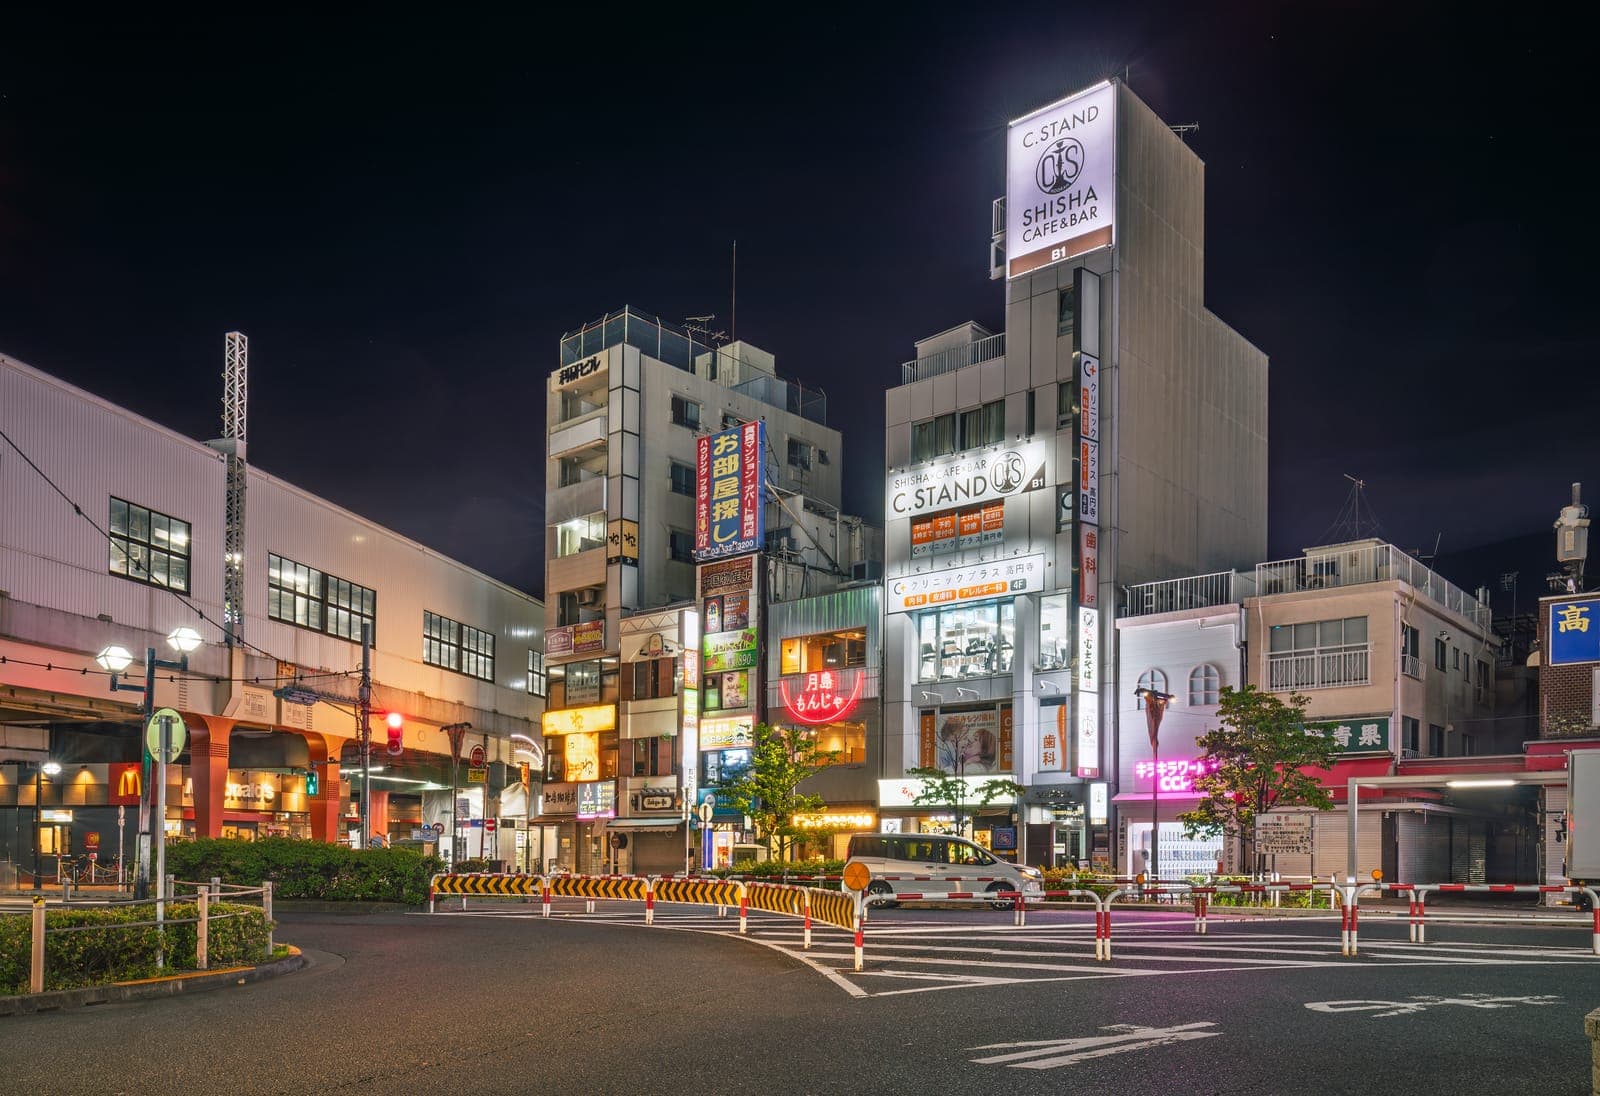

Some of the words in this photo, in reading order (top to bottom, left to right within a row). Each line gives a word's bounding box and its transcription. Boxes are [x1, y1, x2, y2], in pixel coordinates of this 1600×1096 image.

[1022, 105, 1099, 148] C.STAND
[1022, 185, 1098, 227] SHISHA
[1022, 206, 1098, 243] CAFE&BAR
[1051, 246, 1067, 261] B1
[713, 433, 739, 543] お部屋探し
[1032, 477, 1044, 488] B1
[893, 475, 987, 513] C.STAND
[698, 534, 708, 547] 2F
[1086, 532, 1097, 574] 歯科
[1006, 562, 1034, 575] 高円寺
[962, 582, 1003, 596] アレルギー科
[1012, 579, 1024, 589] 4F
[1087, 594, 1095, 604] 2F
[805, 671, 833, 692] 月島
[796, 692, 843, 712] もんじゃ
[1043, 734, 1057, 766] 歯科
